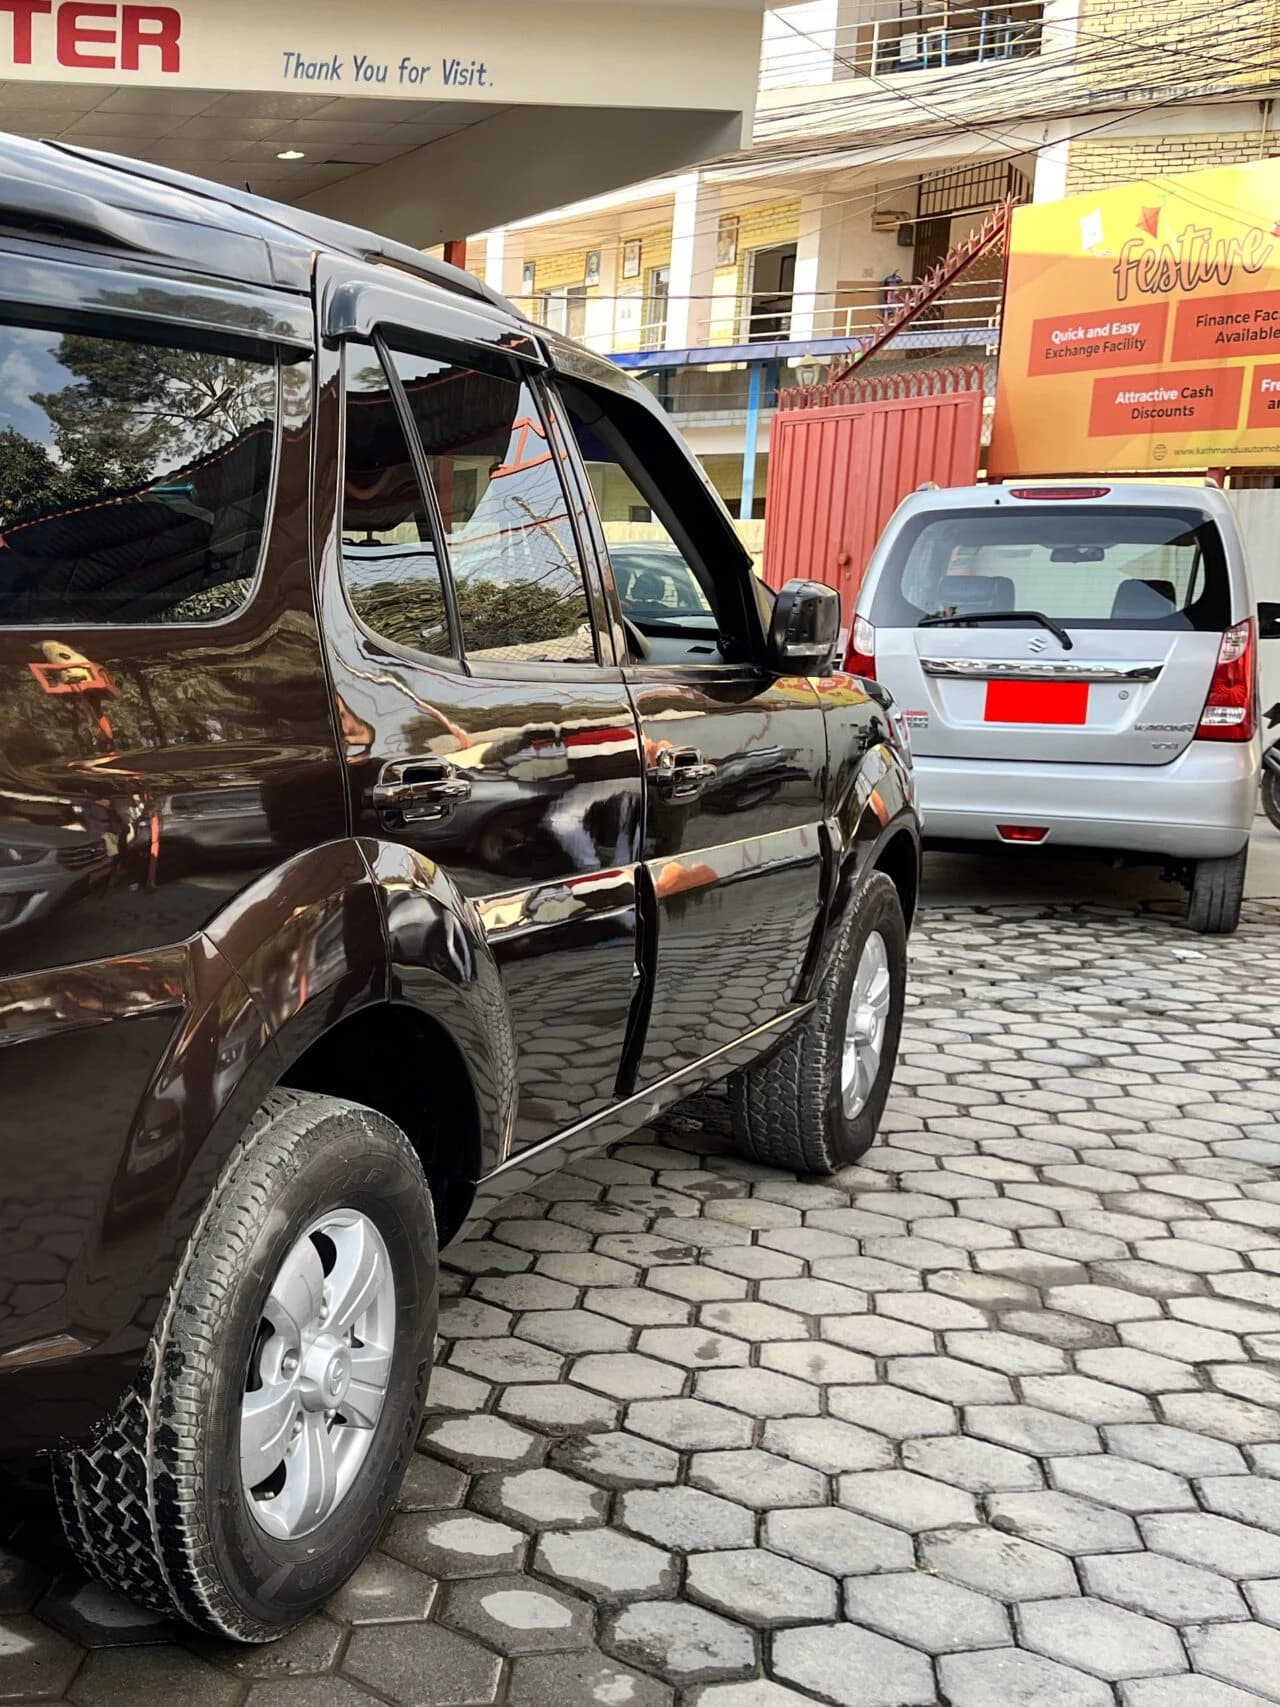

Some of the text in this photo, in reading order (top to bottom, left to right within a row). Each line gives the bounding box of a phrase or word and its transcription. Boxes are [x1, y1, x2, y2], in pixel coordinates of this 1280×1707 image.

[283, 51, 494, 87] Thank You for Visit.
[1196, 313, 1250, 327] Finance
[1051, 321, 1140, 344] Quick and Easy
[1215, 326, 1280, 344] Available
[1045, 338, 1146, 359] Exchange Facility
[1114, 385, 1214, 404] Attractive Cash
[1131, 405, 1195, 420] Discounts
